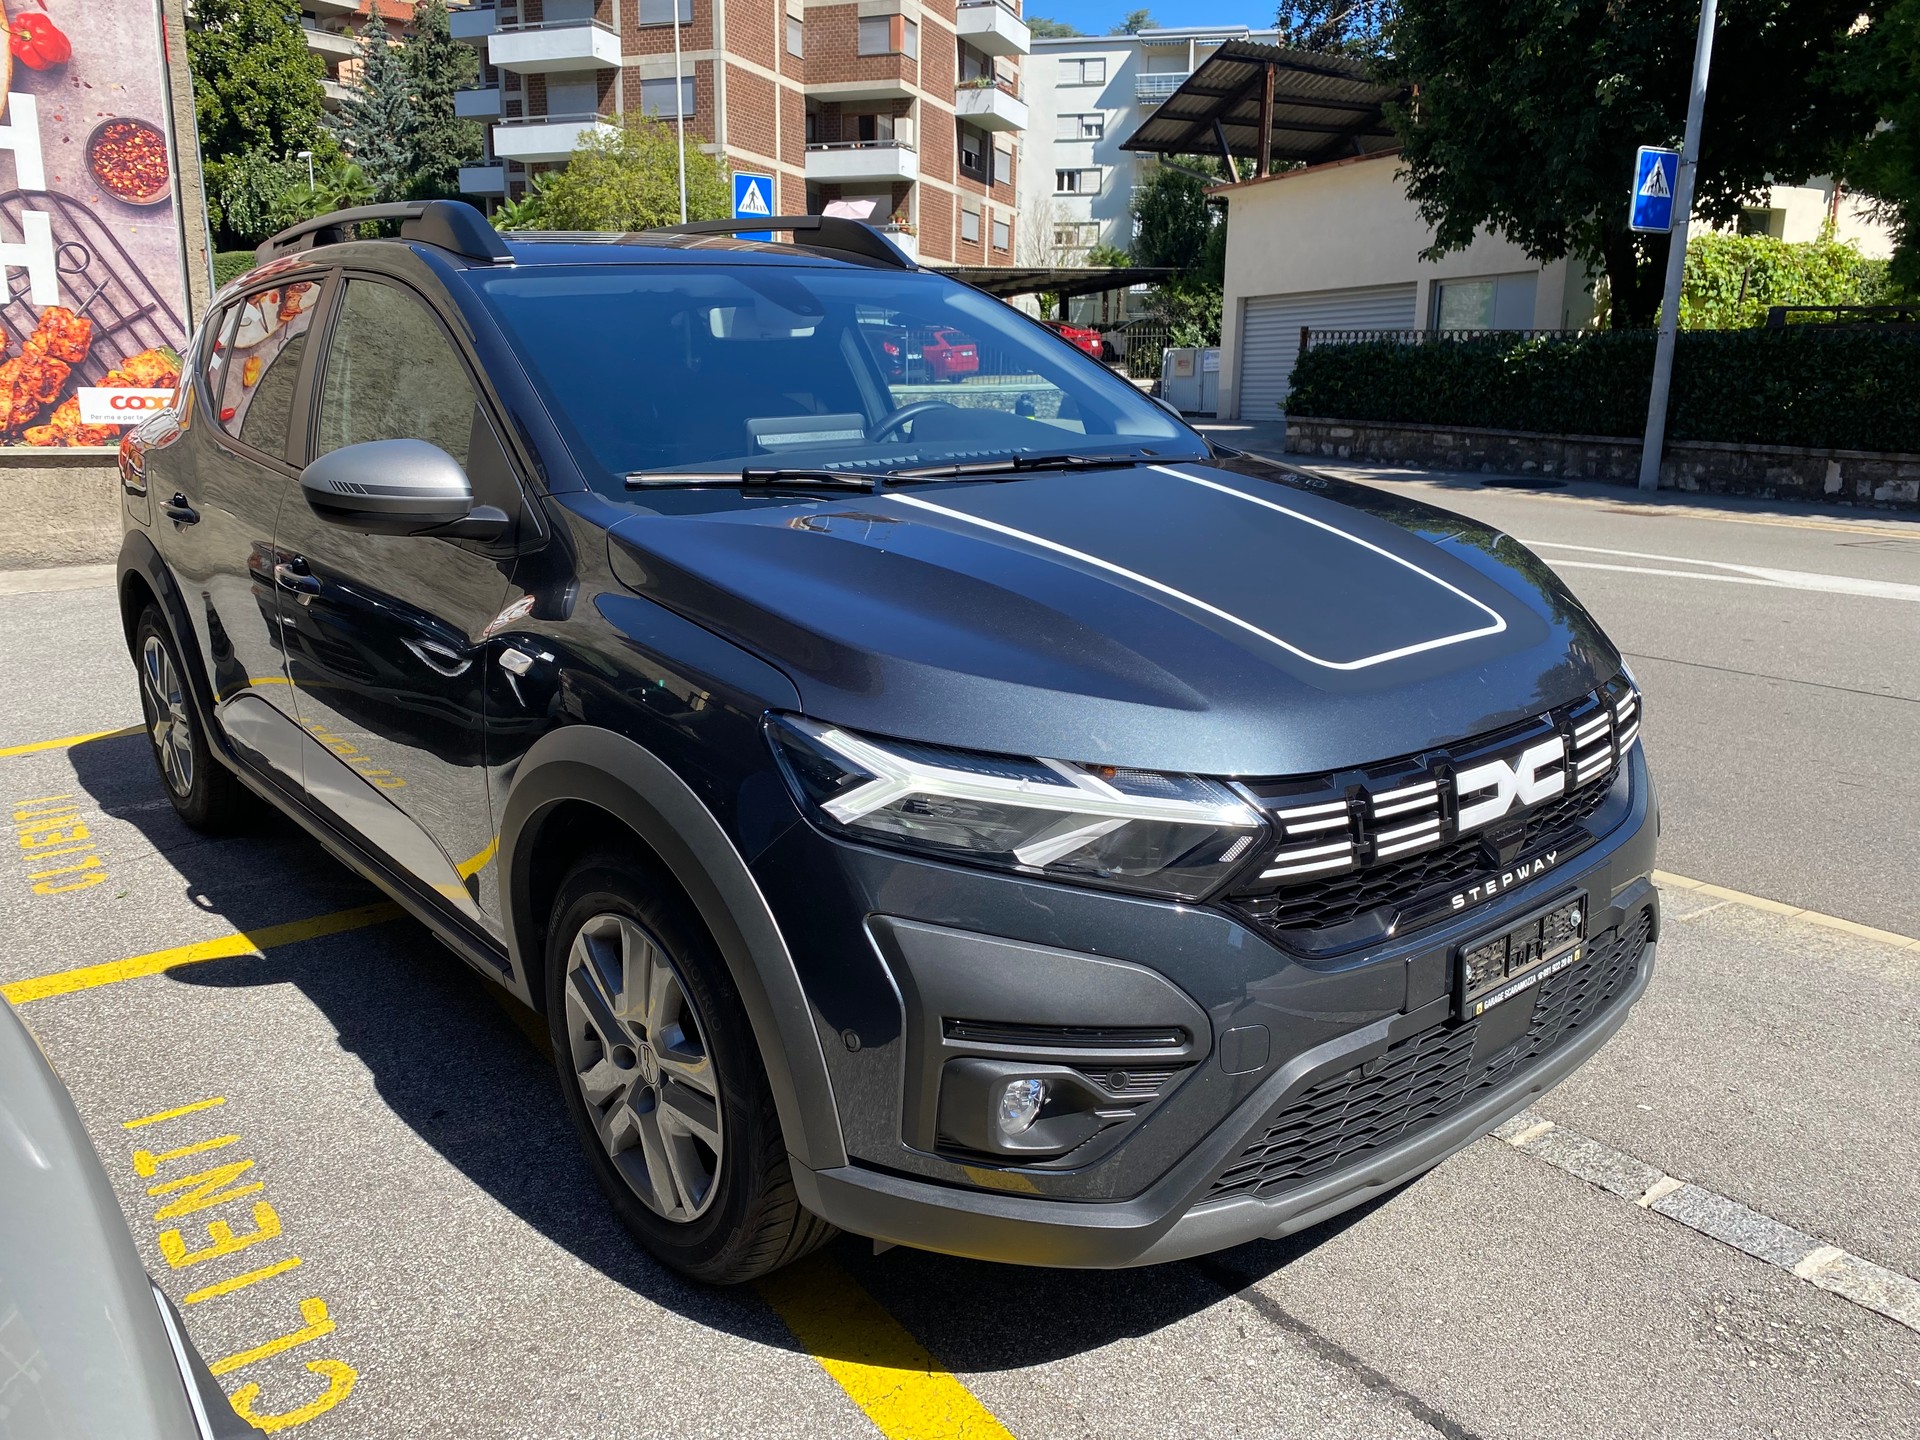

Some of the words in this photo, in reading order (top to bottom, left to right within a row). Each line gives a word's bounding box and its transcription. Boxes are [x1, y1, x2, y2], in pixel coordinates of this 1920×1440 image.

[13, 794, 109, 895] CLIENTI
[1451, 850, 1558, 910] STEPWAY
[681, 950, 722, 1032] MOTRIO
[1484, 991, 1505, 1010] GARAGE
[122, 1096, 358, 1433] CLIENTI
